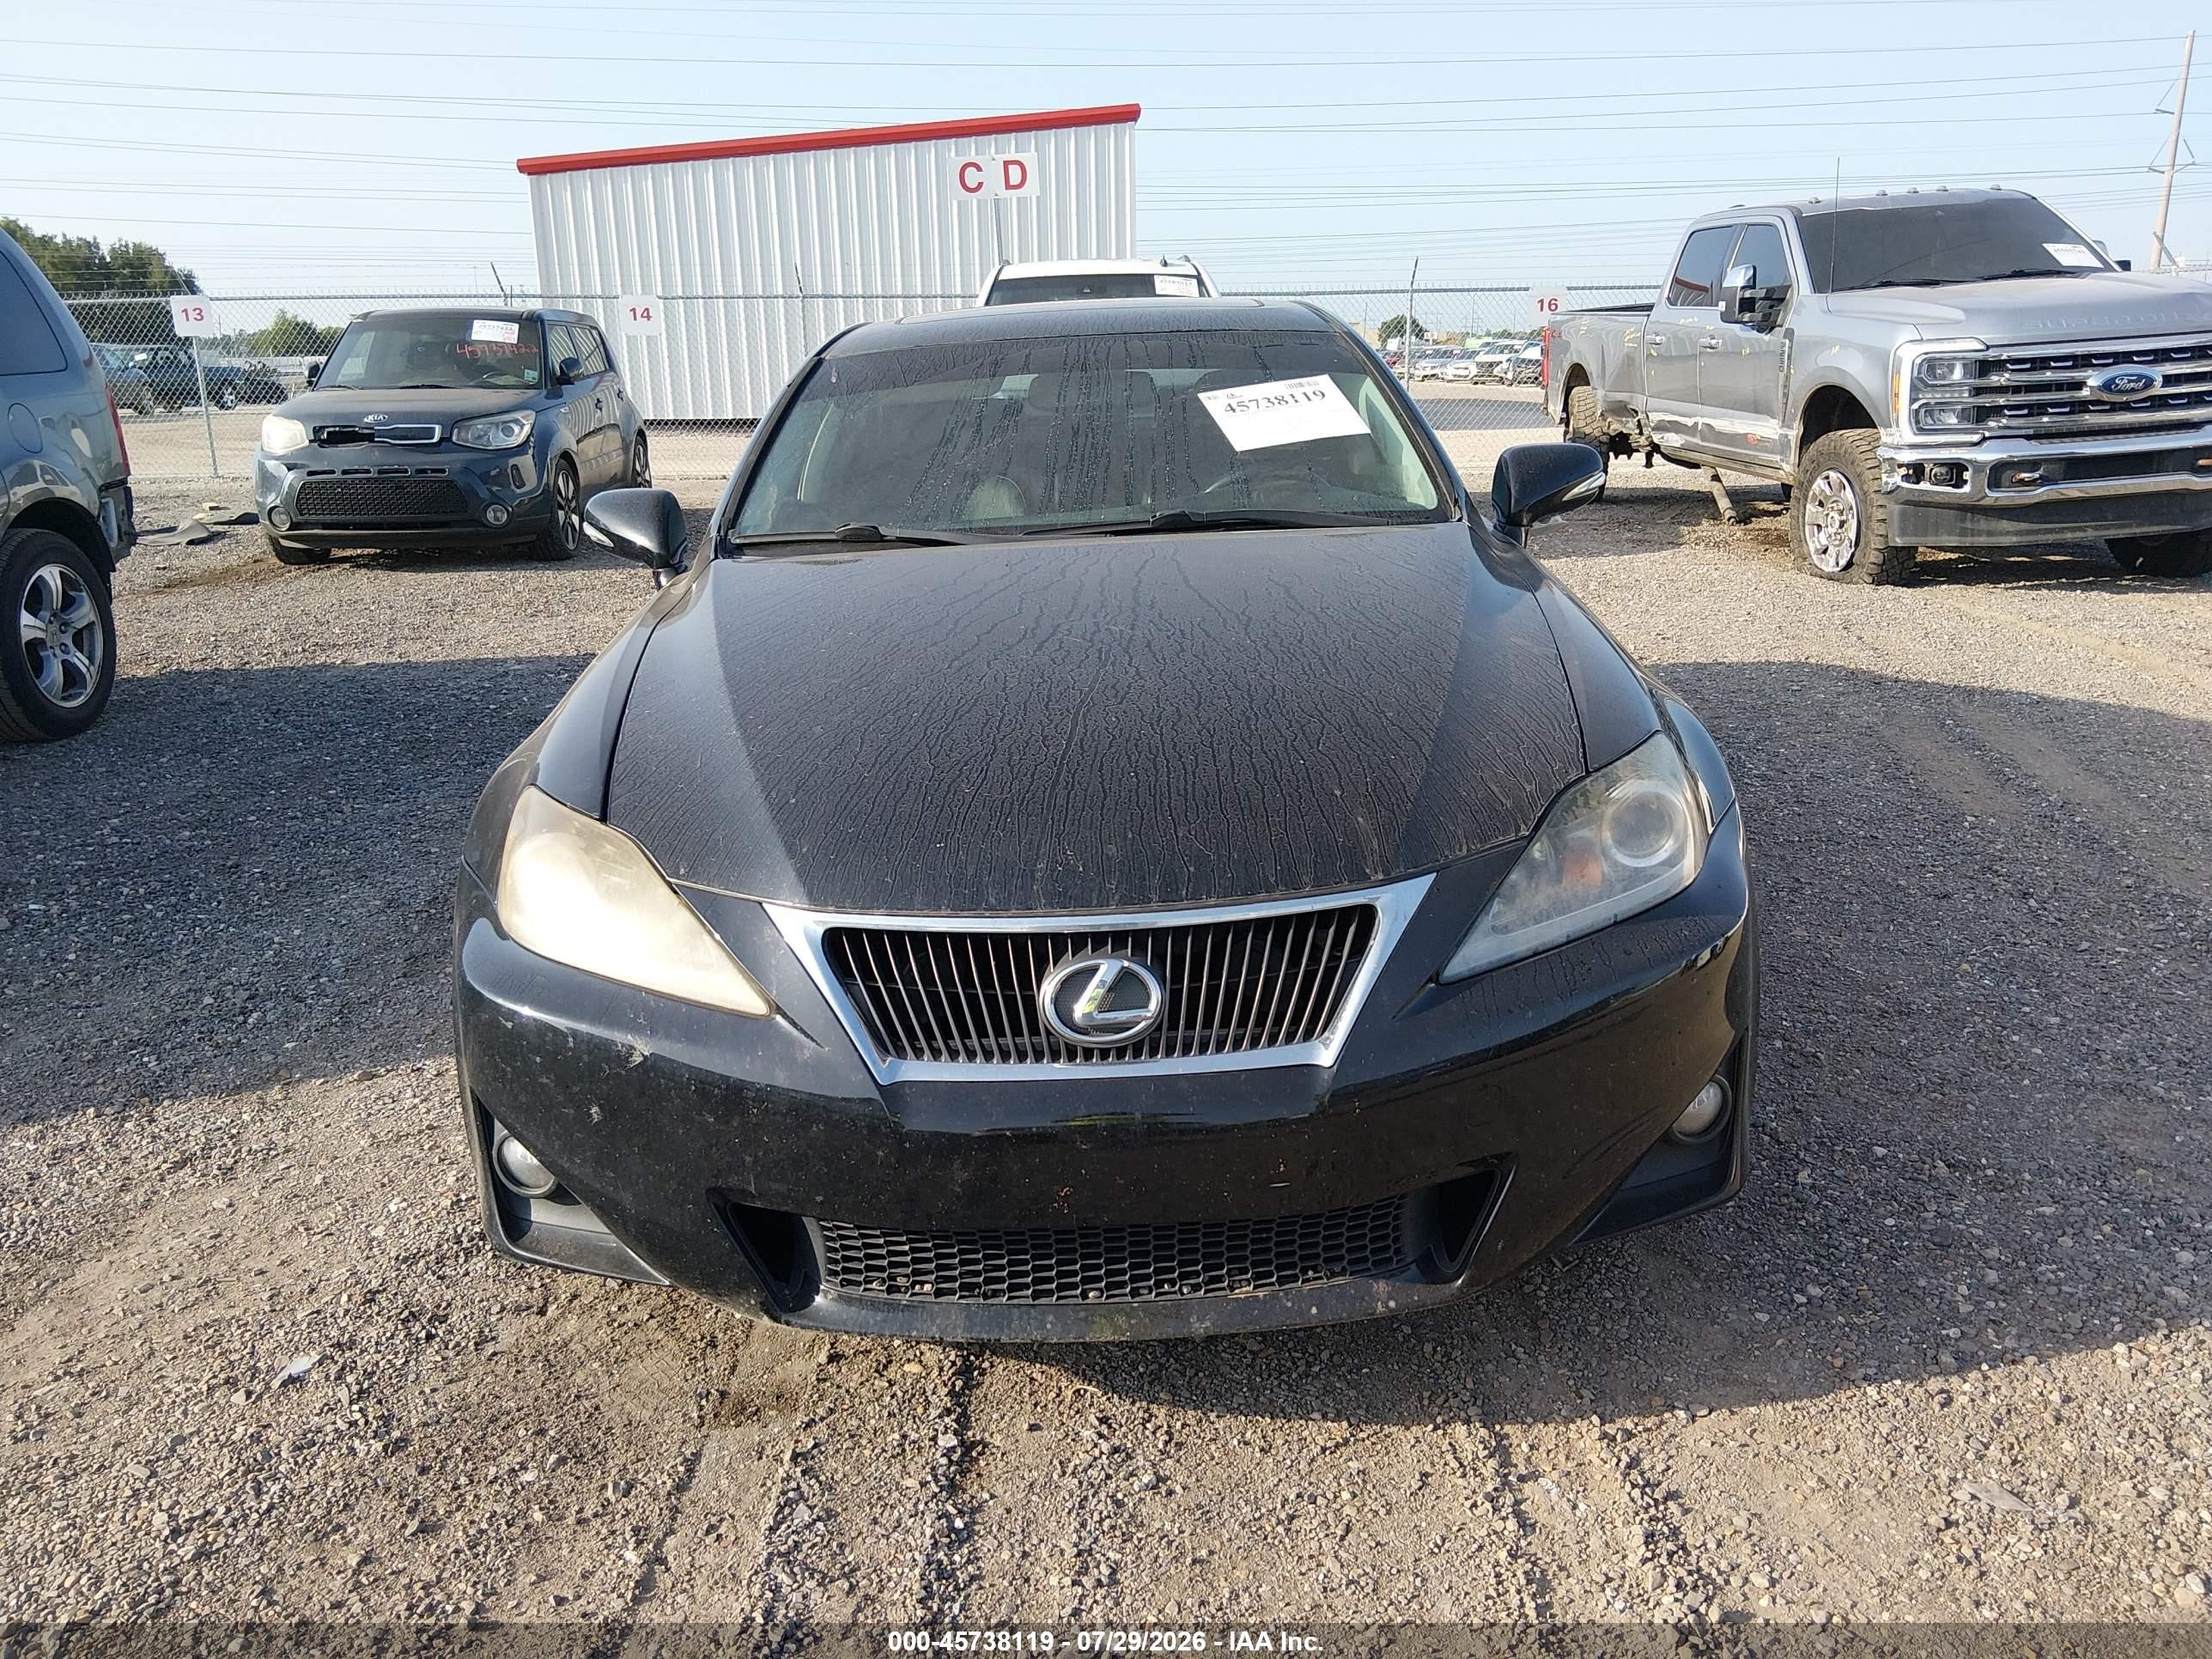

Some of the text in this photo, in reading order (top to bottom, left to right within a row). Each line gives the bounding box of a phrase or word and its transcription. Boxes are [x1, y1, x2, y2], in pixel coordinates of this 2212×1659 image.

[958, 161, 984, 193] C
[1003, 160, 1028, 191] D
[1537, 297, 1559, 313] 16
[180, 307, 204, 322] 13
[629, 307, 653, 321] 14
[2111, 375, 2146, 391] Ford
[1224, 388, 1326, 414] 45738119
